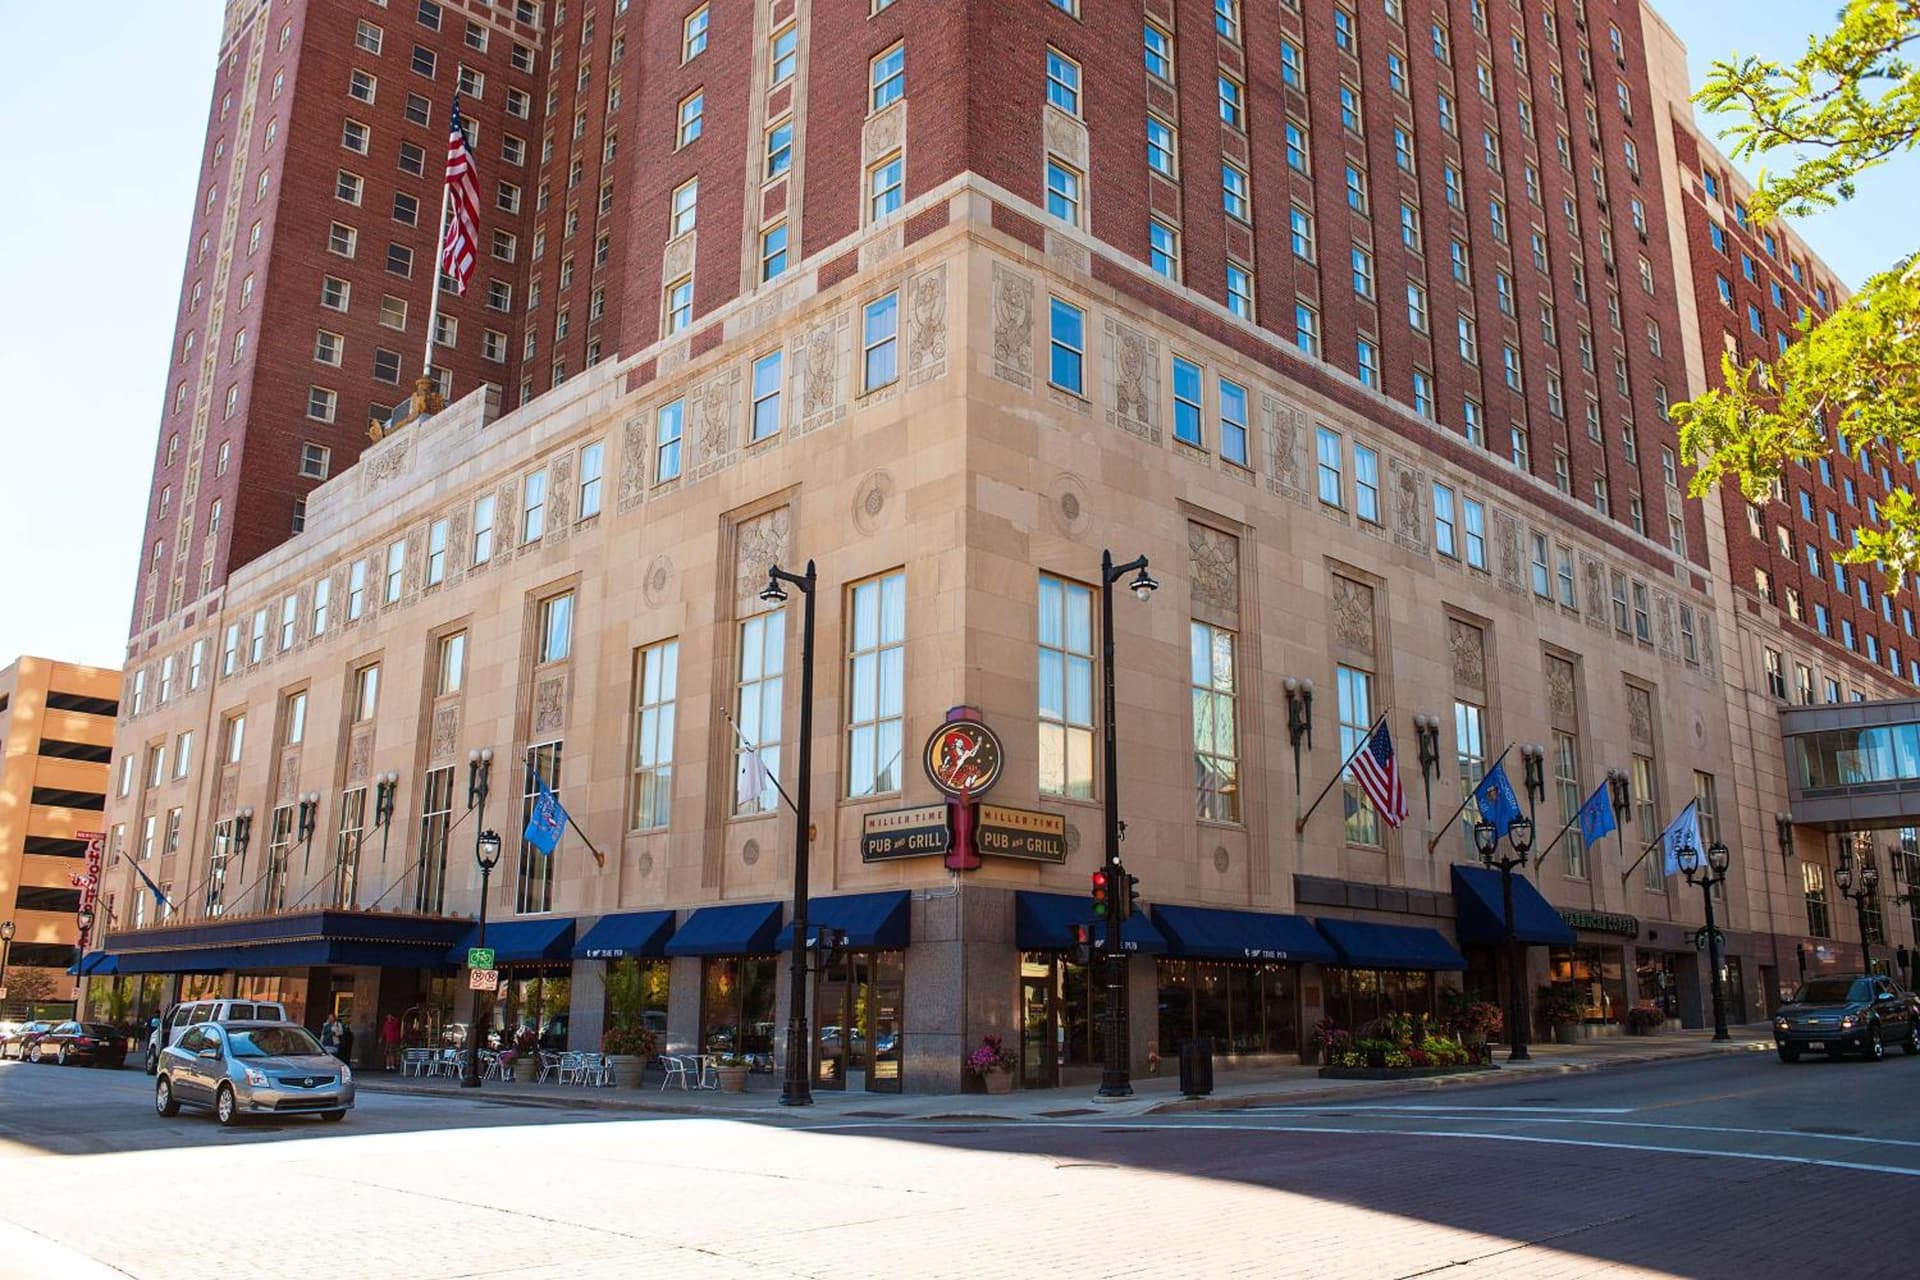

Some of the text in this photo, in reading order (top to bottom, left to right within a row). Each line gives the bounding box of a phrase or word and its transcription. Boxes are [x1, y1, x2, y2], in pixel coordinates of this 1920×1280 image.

[868, 810, 944, 828] MILLER TIME
[983, 810, 1060, 830] MILLER TIME
[868, 838, 892, 854] PUB
[908, 831, 942, 849] GRILL
[983, 832, 1009, 849] PUB
[1026, 838, 1060, 855] GRILL
